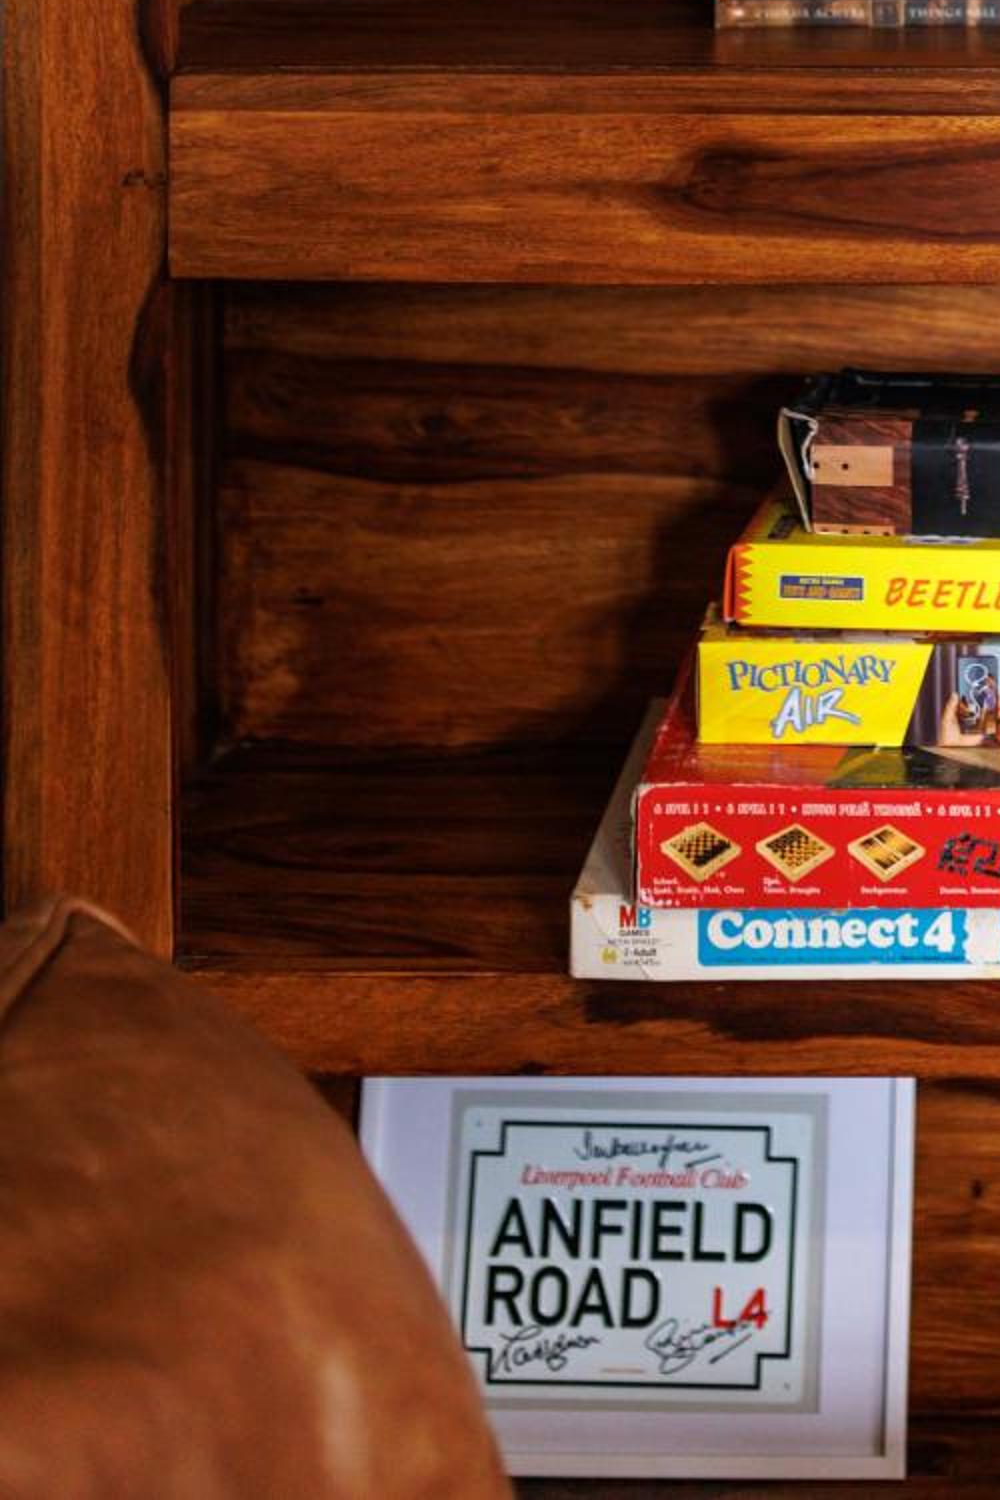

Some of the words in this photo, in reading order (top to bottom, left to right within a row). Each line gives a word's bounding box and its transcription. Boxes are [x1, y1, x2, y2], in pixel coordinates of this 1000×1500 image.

[908, 6, 962, 18] THINGS
[726, 654, 897, 693] PICTIONARY
[772, 687, 860, 739] AIR
[618, 904, 651, 929] MB
[618, 929, 650, 937] GAMES
[707, 910, 919, 950] Connect
[923, 911, 955, 953] 4
[520, 1164, 611, 1190] Liverpool
[615, 1166, 697, 1189] Football
[700, 1167, 749, 1190] Club
[489, 1197, 773, 1264] ANFIELD
[484, 1264, 662, 1329] ROAD
[712, 1285, 769, 1330] L4
